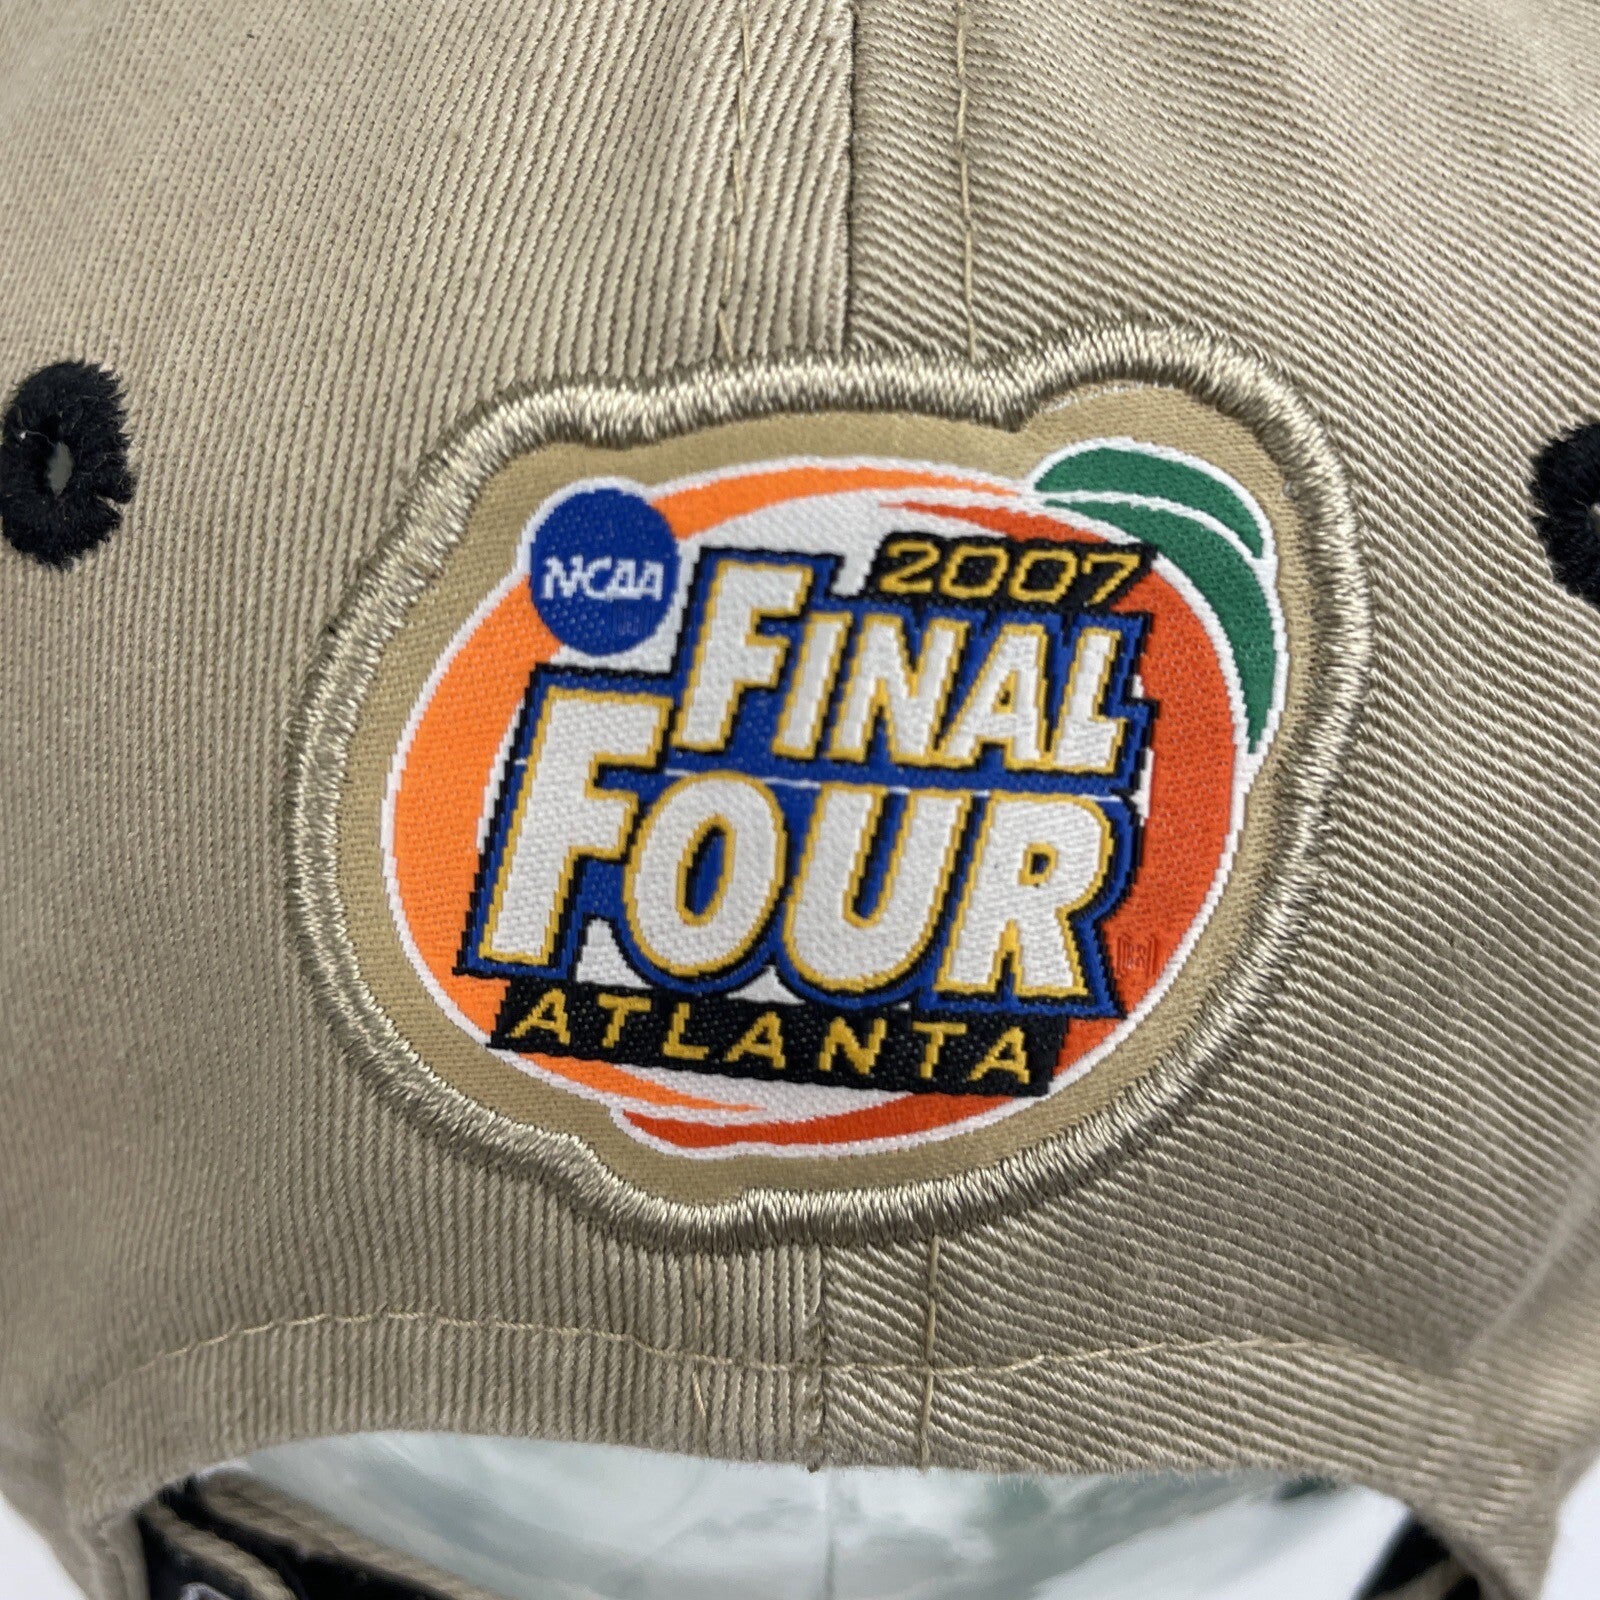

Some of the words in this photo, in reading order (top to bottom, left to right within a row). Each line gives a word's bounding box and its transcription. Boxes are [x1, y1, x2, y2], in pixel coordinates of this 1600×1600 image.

[541, 556, 665, 601] NCAA
[879, 540, 1141, 606] 2007
[671, 559, 1128, 776] FINAL
[478, 685, 1114, 998] FOUR
[510, 988, 1030, 1084] ATLANTA
